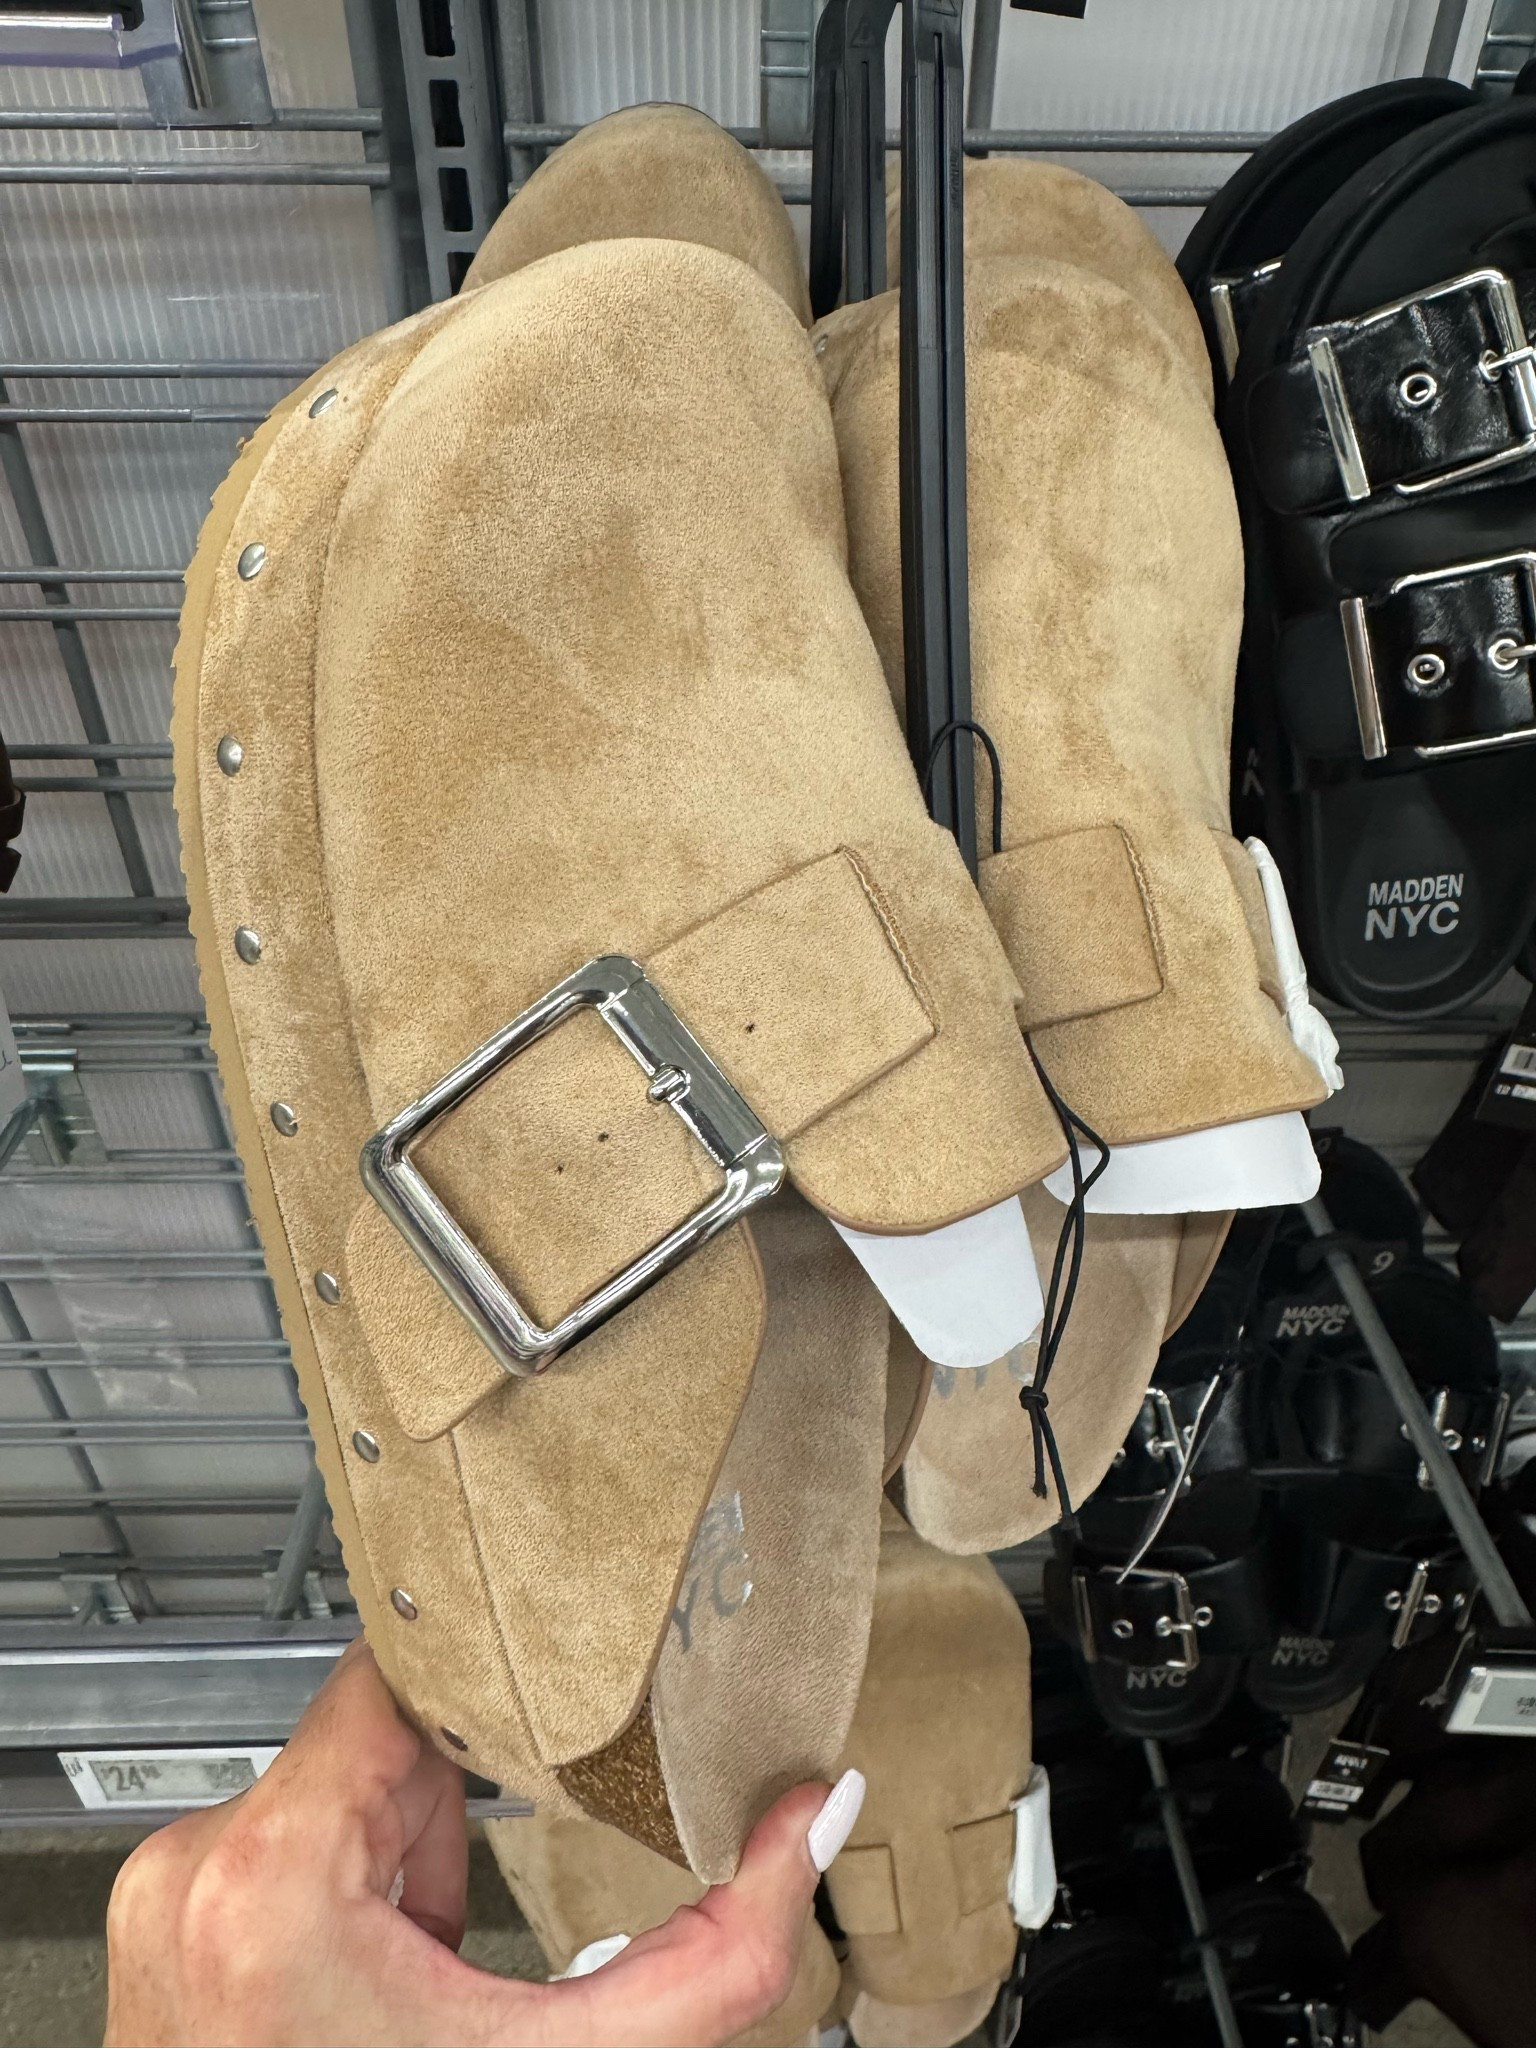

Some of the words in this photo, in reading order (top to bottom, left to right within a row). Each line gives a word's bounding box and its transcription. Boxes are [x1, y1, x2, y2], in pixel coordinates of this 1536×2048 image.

[1368, 873, 1464, 906] MADDEN
[1364, 901, 1460, 941] NYC
[1371, 1251, 1394, 1274] 9
[1276, 1319, 1346, 1338] NYC
[672, 1548, 753, 1652] YC
[1271, 1648, 1330, 1667] NYC
[1126, 1667, 1188, 1690] NYC
